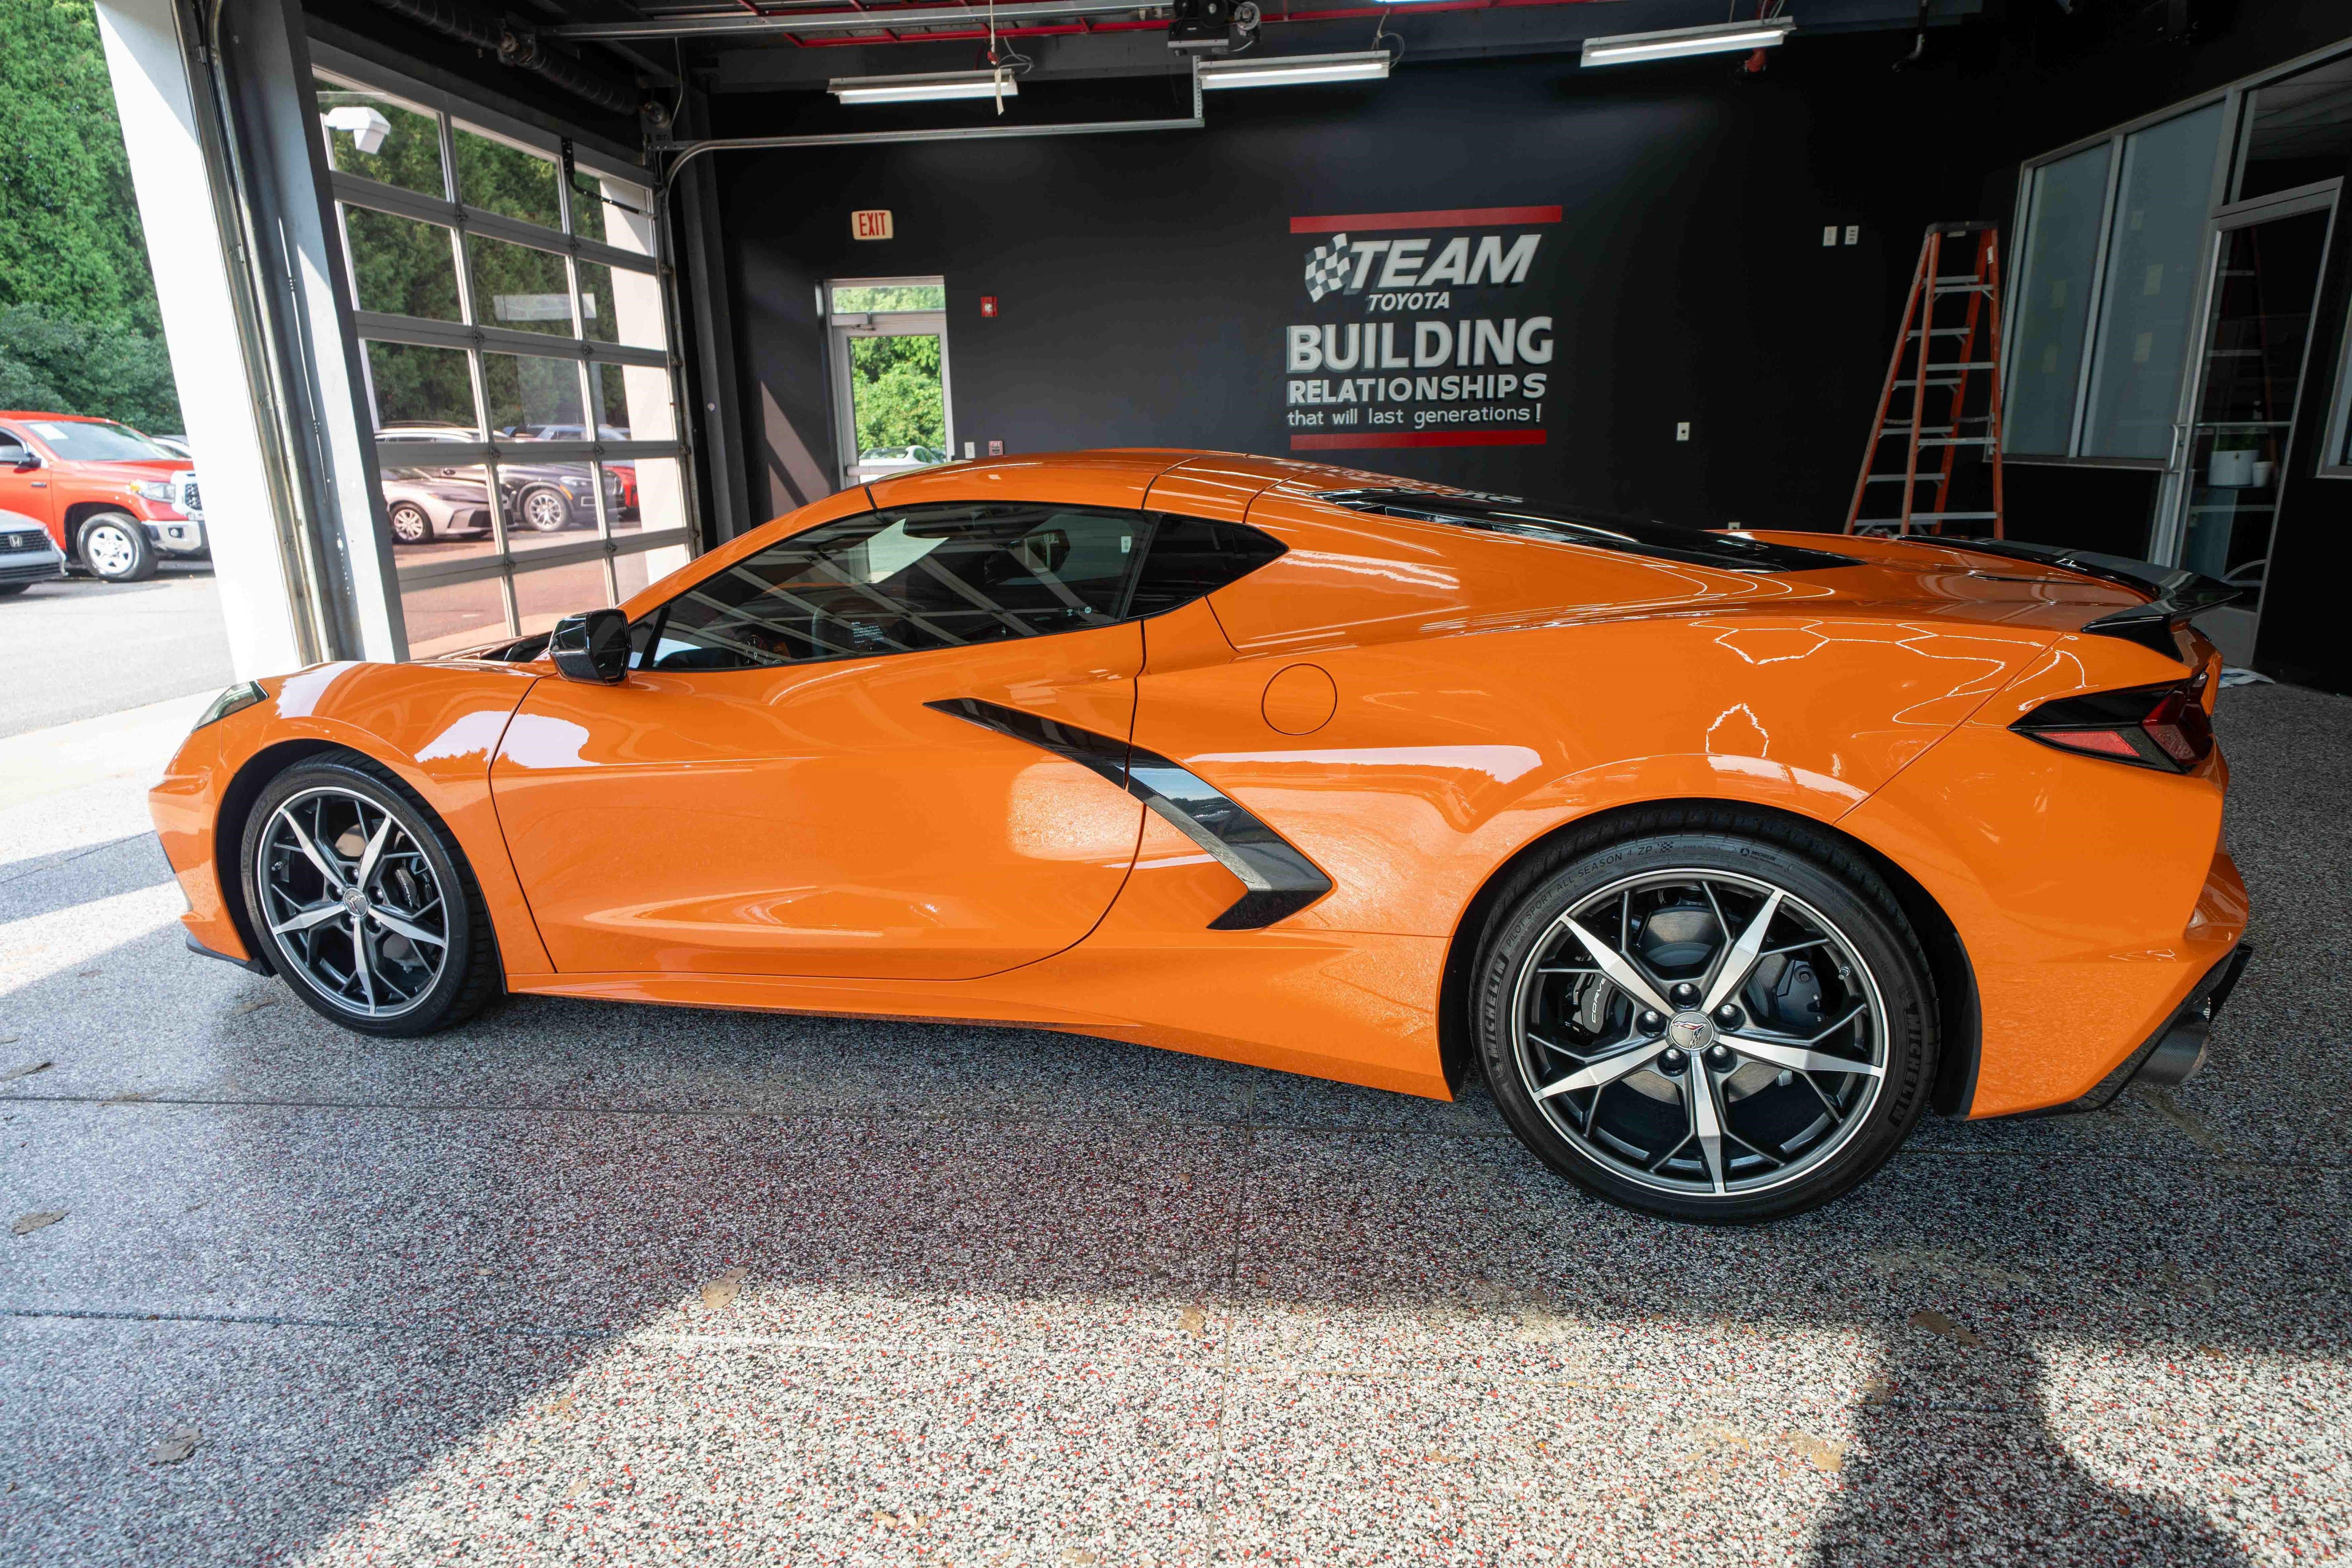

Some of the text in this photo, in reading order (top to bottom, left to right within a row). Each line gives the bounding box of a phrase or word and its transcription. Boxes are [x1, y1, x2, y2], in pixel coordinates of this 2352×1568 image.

[859, 212, 886, 236] EXIT
[1347, 234, 1541, 290] TEAM
[1368, 292, 1450, 312] TOYOTA
[1287, 316, 1553, 372] BUILDING
[1289, 373, 1547, 404] RELATIONSHIPS
[1287, 403, 1541, 429] that will last generations!
[1506, 919, 1526, 948] PILOT
[1526, 889, 1552, 919] SPORT
[1557, 875, 1575, 892] ALL
[1578, 852, 1622, 877] SEASON
[1638, 846, 1653, 855] ZP
[1485, 959, 1506, 1058] MICHELIN
[1592, 978, 1606, 1023] CORVE
[1892, 1013, 1920, 1123] MICHELIN
